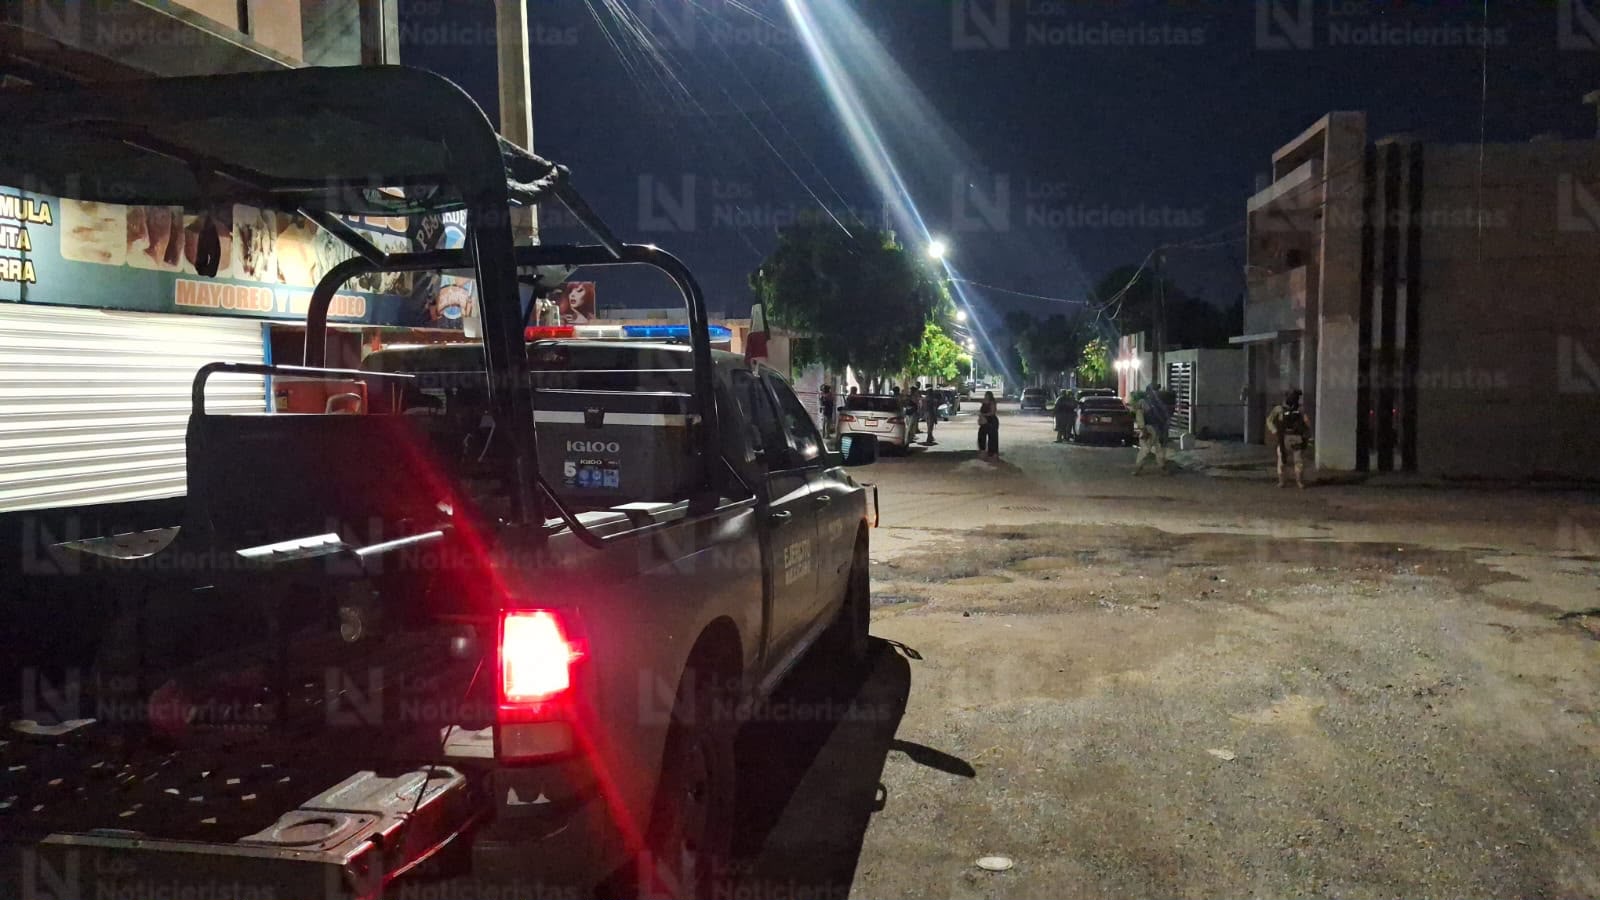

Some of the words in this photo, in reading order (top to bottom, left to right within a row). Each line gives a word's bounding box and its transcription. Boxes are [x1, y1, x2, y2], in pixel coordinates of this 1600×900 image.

[175, 279, 273, 312] MAYOREO
[274, 287, 290, 313] Y
[566, 440, 620, 453] IGLOO
